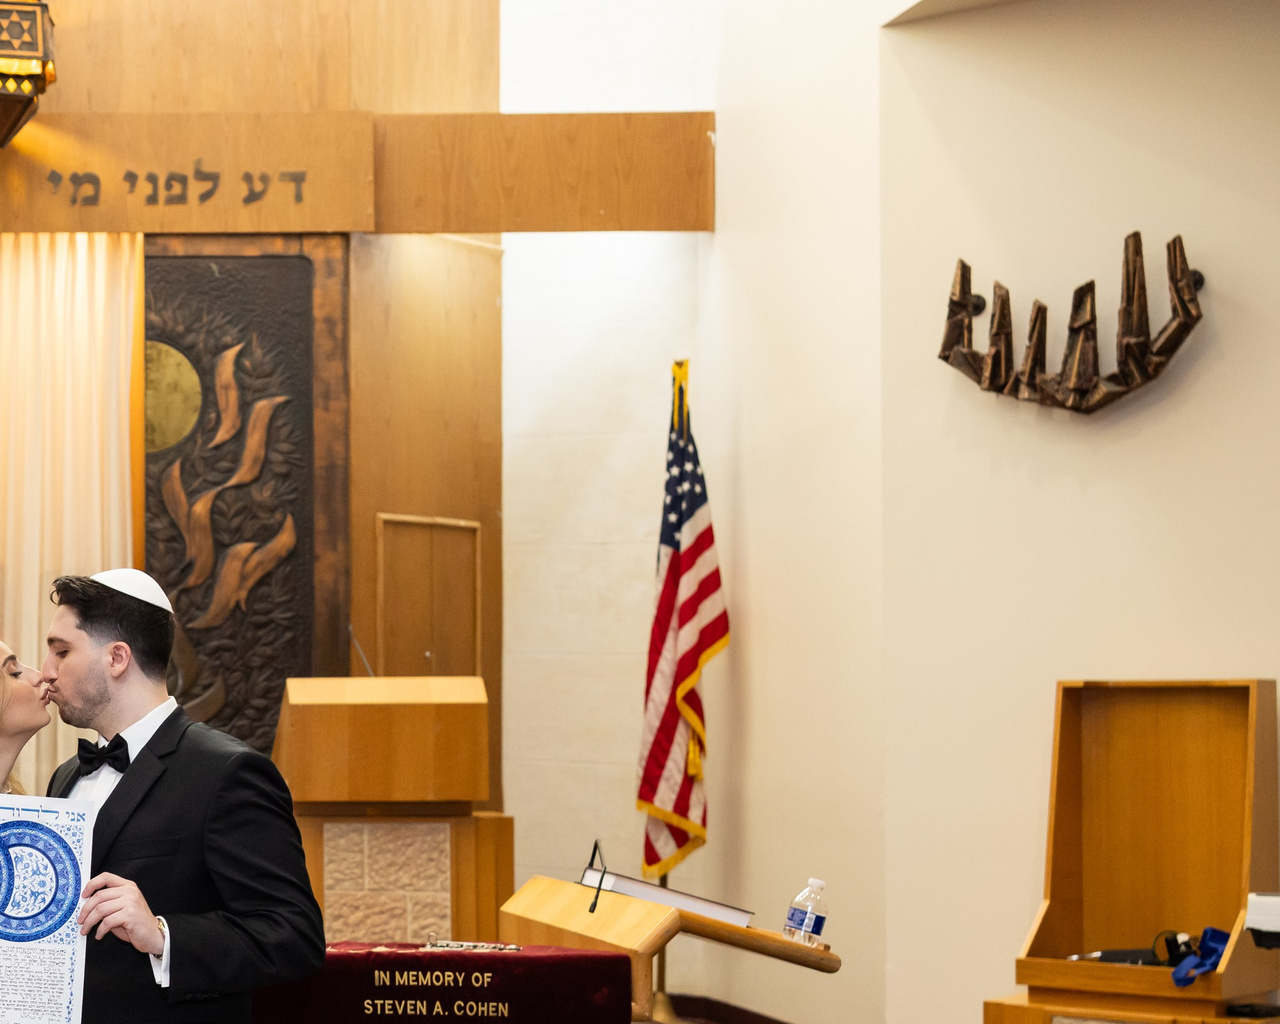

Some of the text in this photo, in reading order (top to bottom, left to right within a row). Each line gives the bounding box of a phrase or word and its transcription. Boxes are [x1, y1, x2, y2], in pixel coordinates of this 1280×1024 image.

[47, 169, 101, 207] מי
[123, 157, 221, 206] לפני
[242, 169, 307, 206] דע
[65, 810, 86, 823] אני
[374, 970, 493, 988] IN MEMORY OF
[364, 1000, 509, 1017] STEVEN A. COHEN
